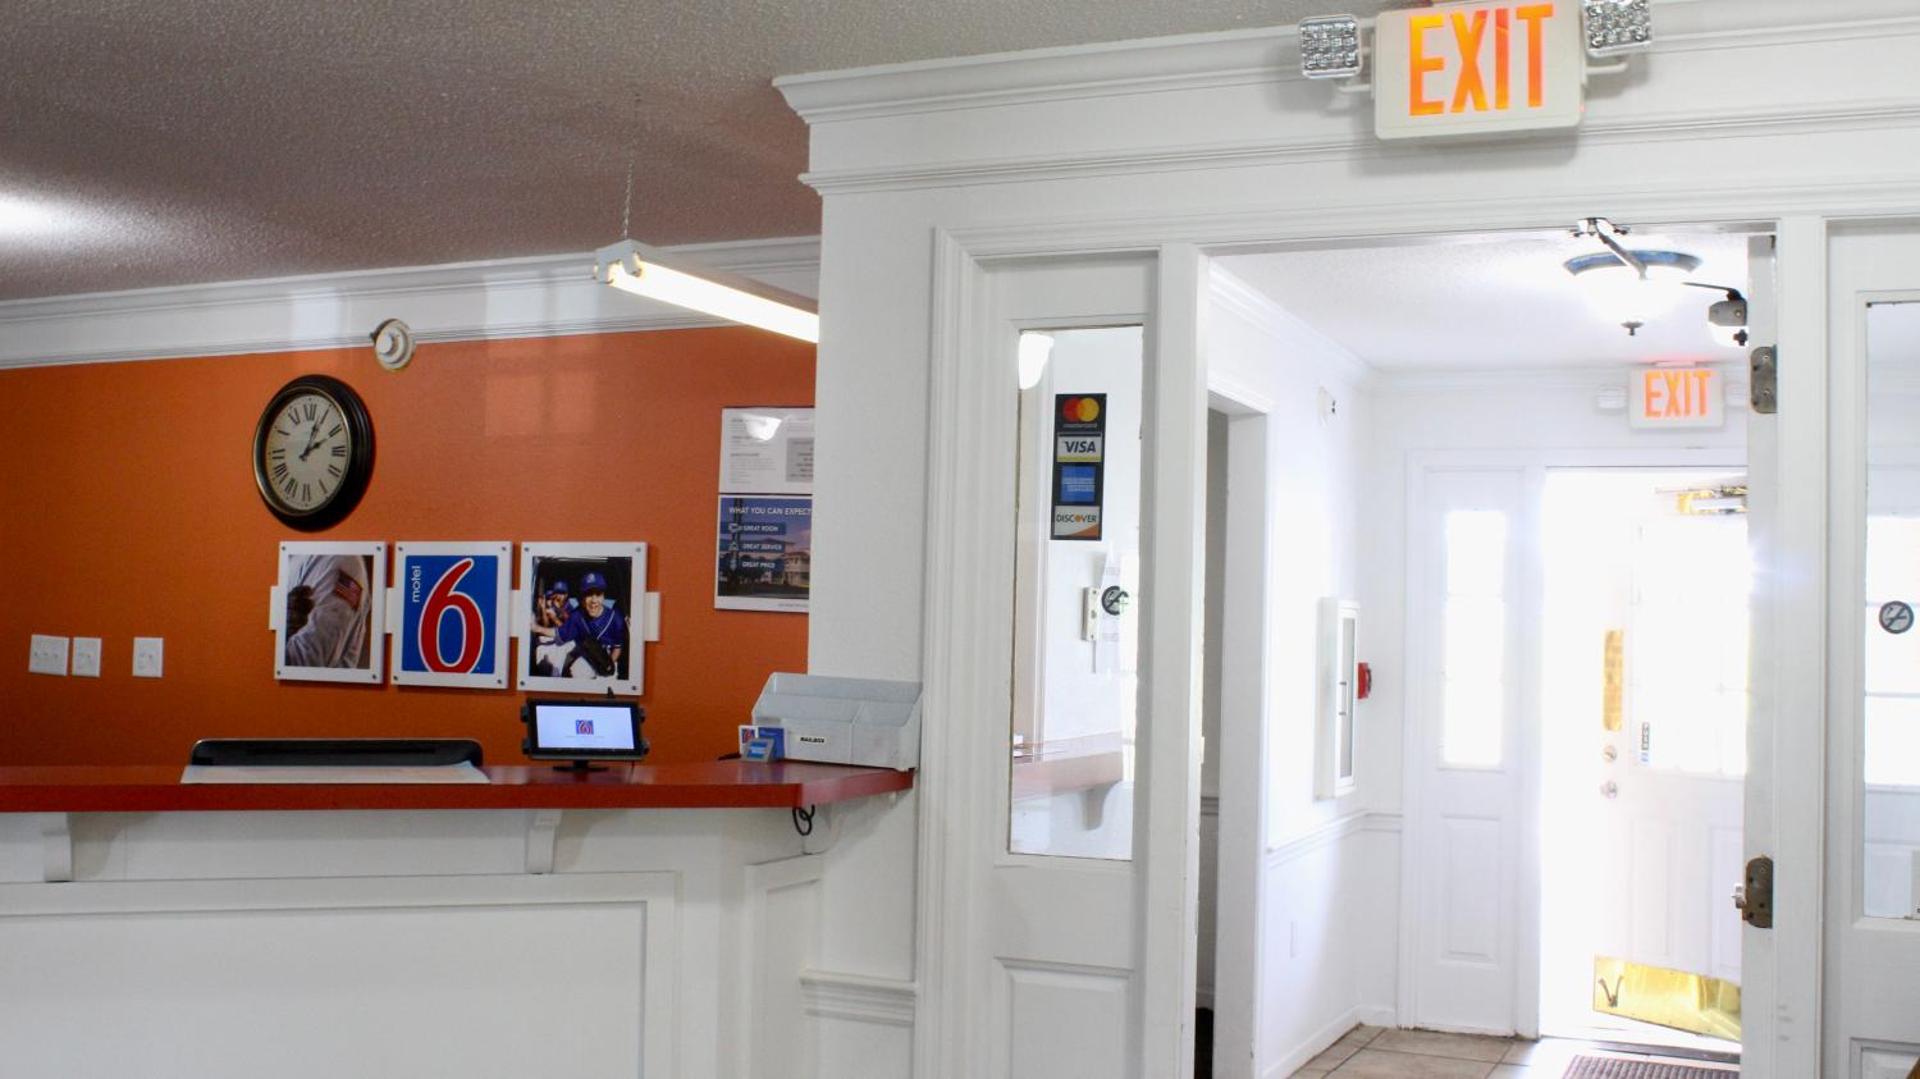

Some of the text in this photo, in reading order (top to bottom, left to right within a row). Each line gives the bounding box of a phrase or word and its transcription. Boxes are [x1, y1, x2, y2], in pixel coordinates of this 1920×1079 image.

[1409, 4, 1553, 116] EXIT
[1644, 370, 1711, 417] EXIT
[1065, 441, 1096, 453] VISA
[728, 506, 749, 514] WHAT
[750, 506, 766, 514] YOU
[767, 507, 783, 515] CAN
[1056, 513, 1097, 523] DISCOVER
[411, 565, 422, 602] motel
[418, 557, 484, 673] 6
